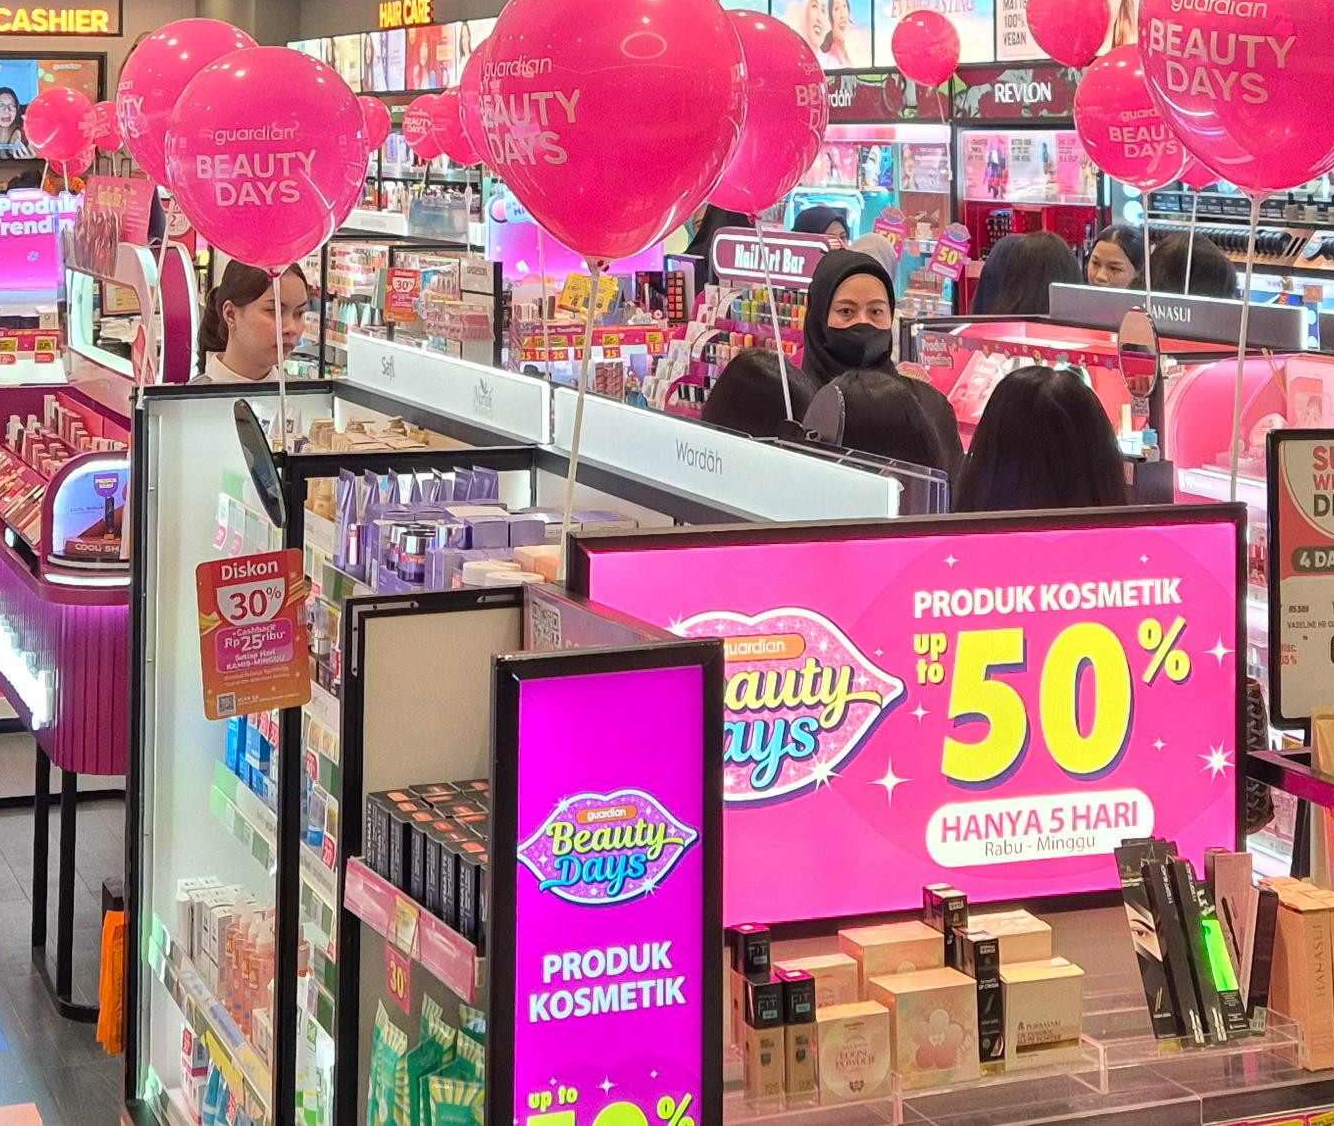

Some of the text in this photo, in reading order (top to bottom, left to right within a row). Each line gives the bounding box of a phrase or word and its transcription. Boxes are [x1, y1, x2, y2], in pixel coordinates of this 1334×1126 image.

[379, 0, 402, 27] HAIR
[1003, 32, 1027, 46] VEGAN
[1149, 17, 1297, 69] BEAUTY
[485, 56, 552, 78] guardian
[994, 82, 1052, 103] REVLON
[1166, 61, 1269, 104] DAYS
[479, 89, 581, 128] BEAUTY
[215, 125, 295, 146] guardian
[490, 131, 568, 166] DAYS
[1124, 138, 1178, 157] DAYS
[196, 150, 317, 179] BEAUTY
[216, 180, 301, 206] DAYS
[734, 243, 759, 269] Nail
[783, 250, 806, 274] Bar
[221, 559, 278, 581] Diskon
[1300, 549, 1311, 567] 4
[914, 578, 1182, 619] PRODUK KOSMETIK
[914, 633, 947, 662] up
[917, 658, 944, 686] to
[725, 660, 884, 730] auty
[941, 615, 1191, 782] 50%
[724, 715, 820, 788] ays
[587, 807, 628, 820] guardian
[941, 801, 1139, 844] HANYA 5 HARI
[546, 814, 684, 859] Beauty
[984, 833, 1096, 857] Rabu Minggu
[540, 850, 647, 896] Days
[542, 940, 672, 984] PRODUK
[1315, 923, 1328, 998] HANASUI
[528, 977, 686, 1023] KOSMETIK
[528, 1092, 552, 1110] up
[557, 1084, 578, 1104] to
